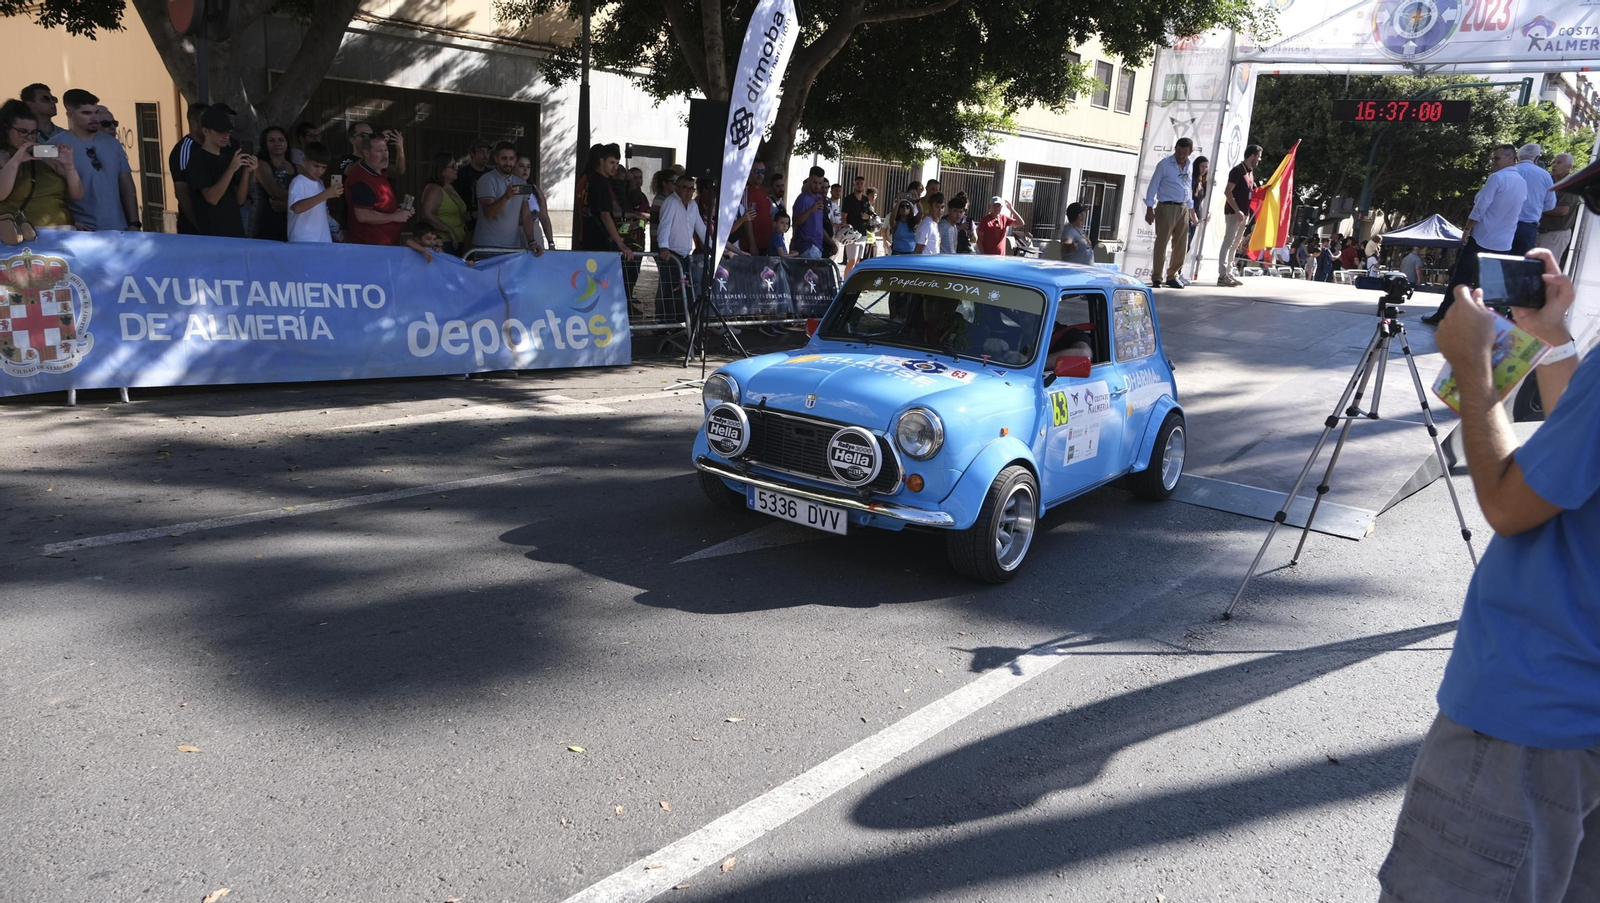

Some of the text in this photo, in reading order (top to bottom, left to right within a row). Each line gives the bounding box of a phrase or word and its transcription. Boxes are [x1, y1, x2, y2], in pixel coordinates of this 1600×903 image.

[1460, 0, 1511, 33] 2023
[1558, 26, 1599, 36] COSTA
[747, 11, 785, 104] dimoba
[1355, 101, 1443, 122] 16:37:00
[1153, 145, 1203, 153] CUA
[117, 275, 386, 309] AYUNTAMIENTO
[944, 282, 980, 296] JOYA
[118, 310, 335, 341] DE ALMERÍA
[407, 309, 614, 367] deportes
[820, 356, 938, 386] CLAUSE
[950, 370, 968, 380] 63
[1122, 367, 1157, 392] DHARMA
[1052, 391, 1069, 426] 63
[710, 423, 739, 439] Hella
[834, 449, 870, 466] Hella
[758, 491, 840, 530] 5336 DVV
